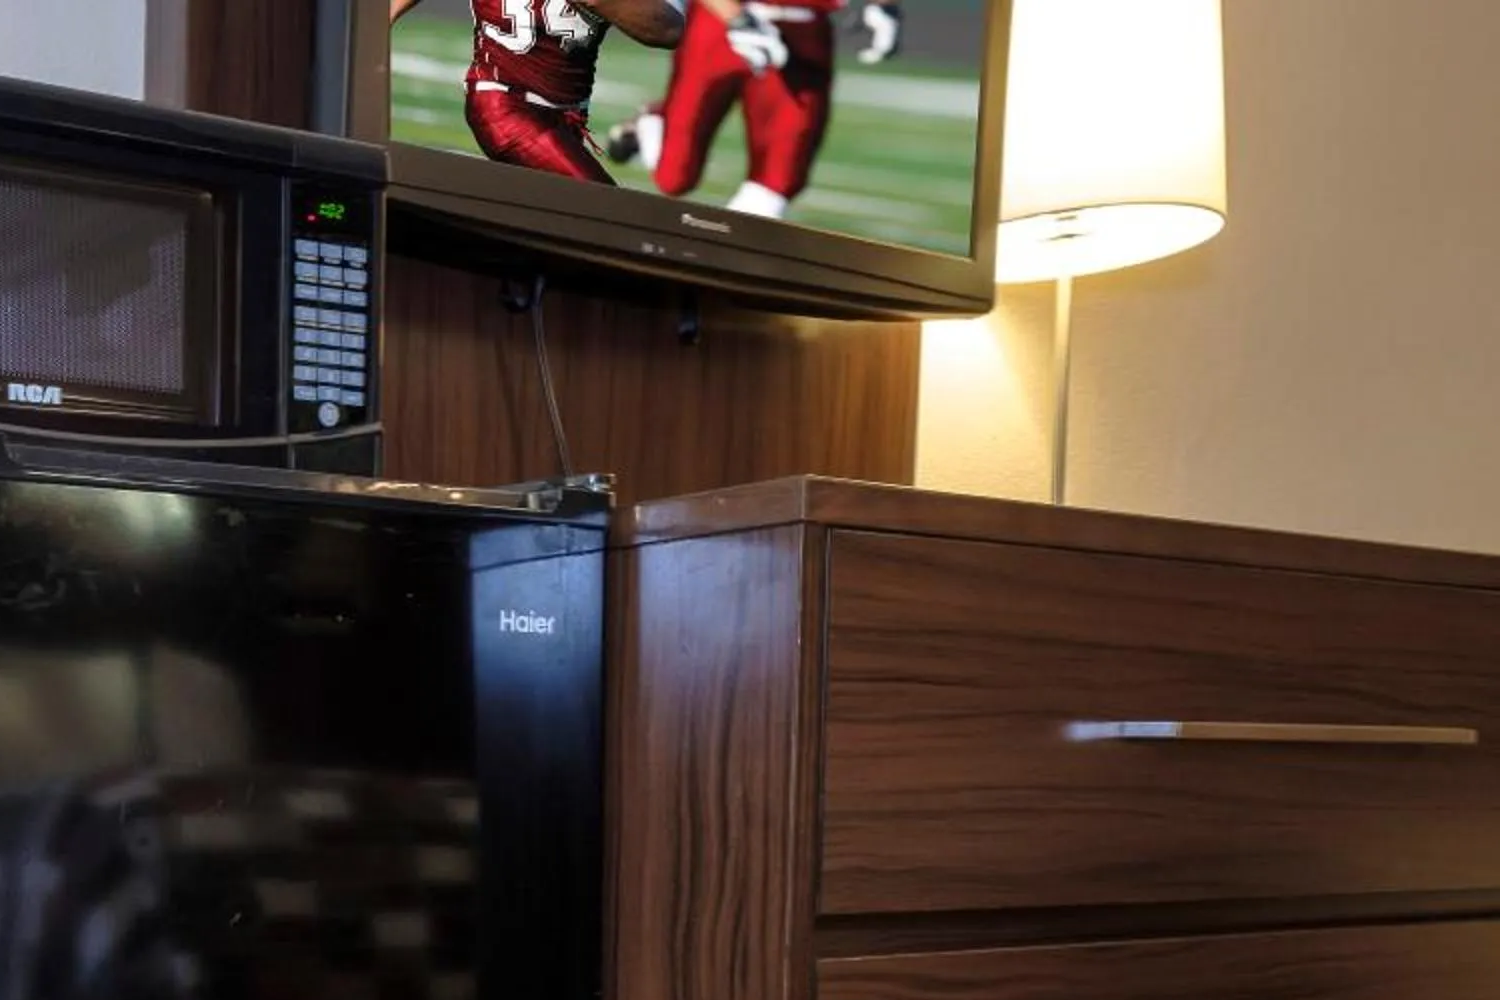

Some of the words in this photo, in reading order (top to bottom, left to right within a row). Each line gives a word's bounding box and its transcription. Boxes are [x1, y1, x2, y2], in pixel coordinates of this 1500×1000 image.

[481, 0, 590, 55] 34
[7, 383, 62, 404] RCA
[500, 609, 556, 634] Haier
